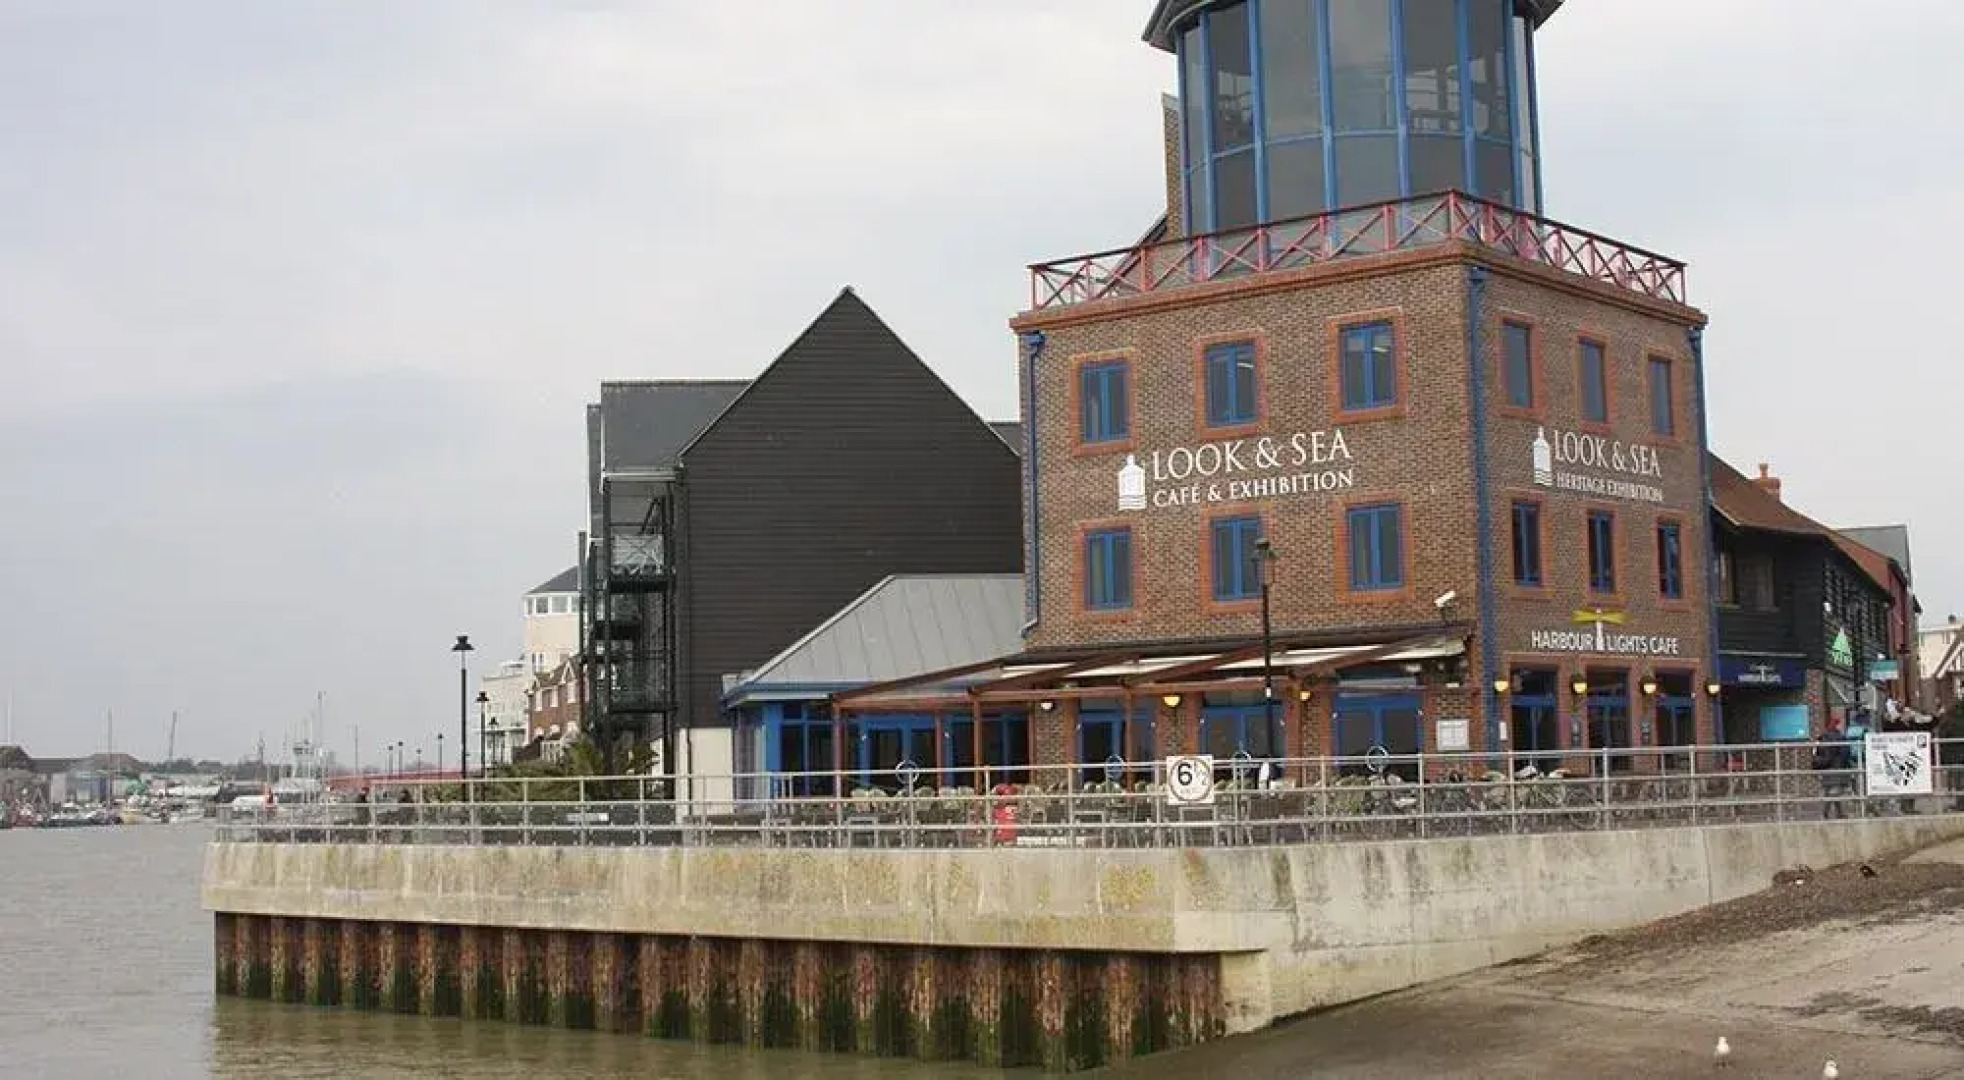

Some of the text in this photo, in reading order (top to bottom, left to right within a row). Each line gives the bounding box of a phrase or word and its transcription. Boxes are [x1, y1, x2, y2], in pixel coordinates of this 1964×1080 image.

[1152, 428, 1353, 481] LOOK & SEA
[1554, 429, 1662, 478] LOOK & SEA
[1207, 484, 1223, 501] &
[1229, 469, 1354, 500] EXHIBITION
[1556, 472, 1663, 501] HERITAGE EXHIBITION
[1531, 629, 1593, 651] HARBOUR
[1605, 633, 1648, 654] LIGHTS
